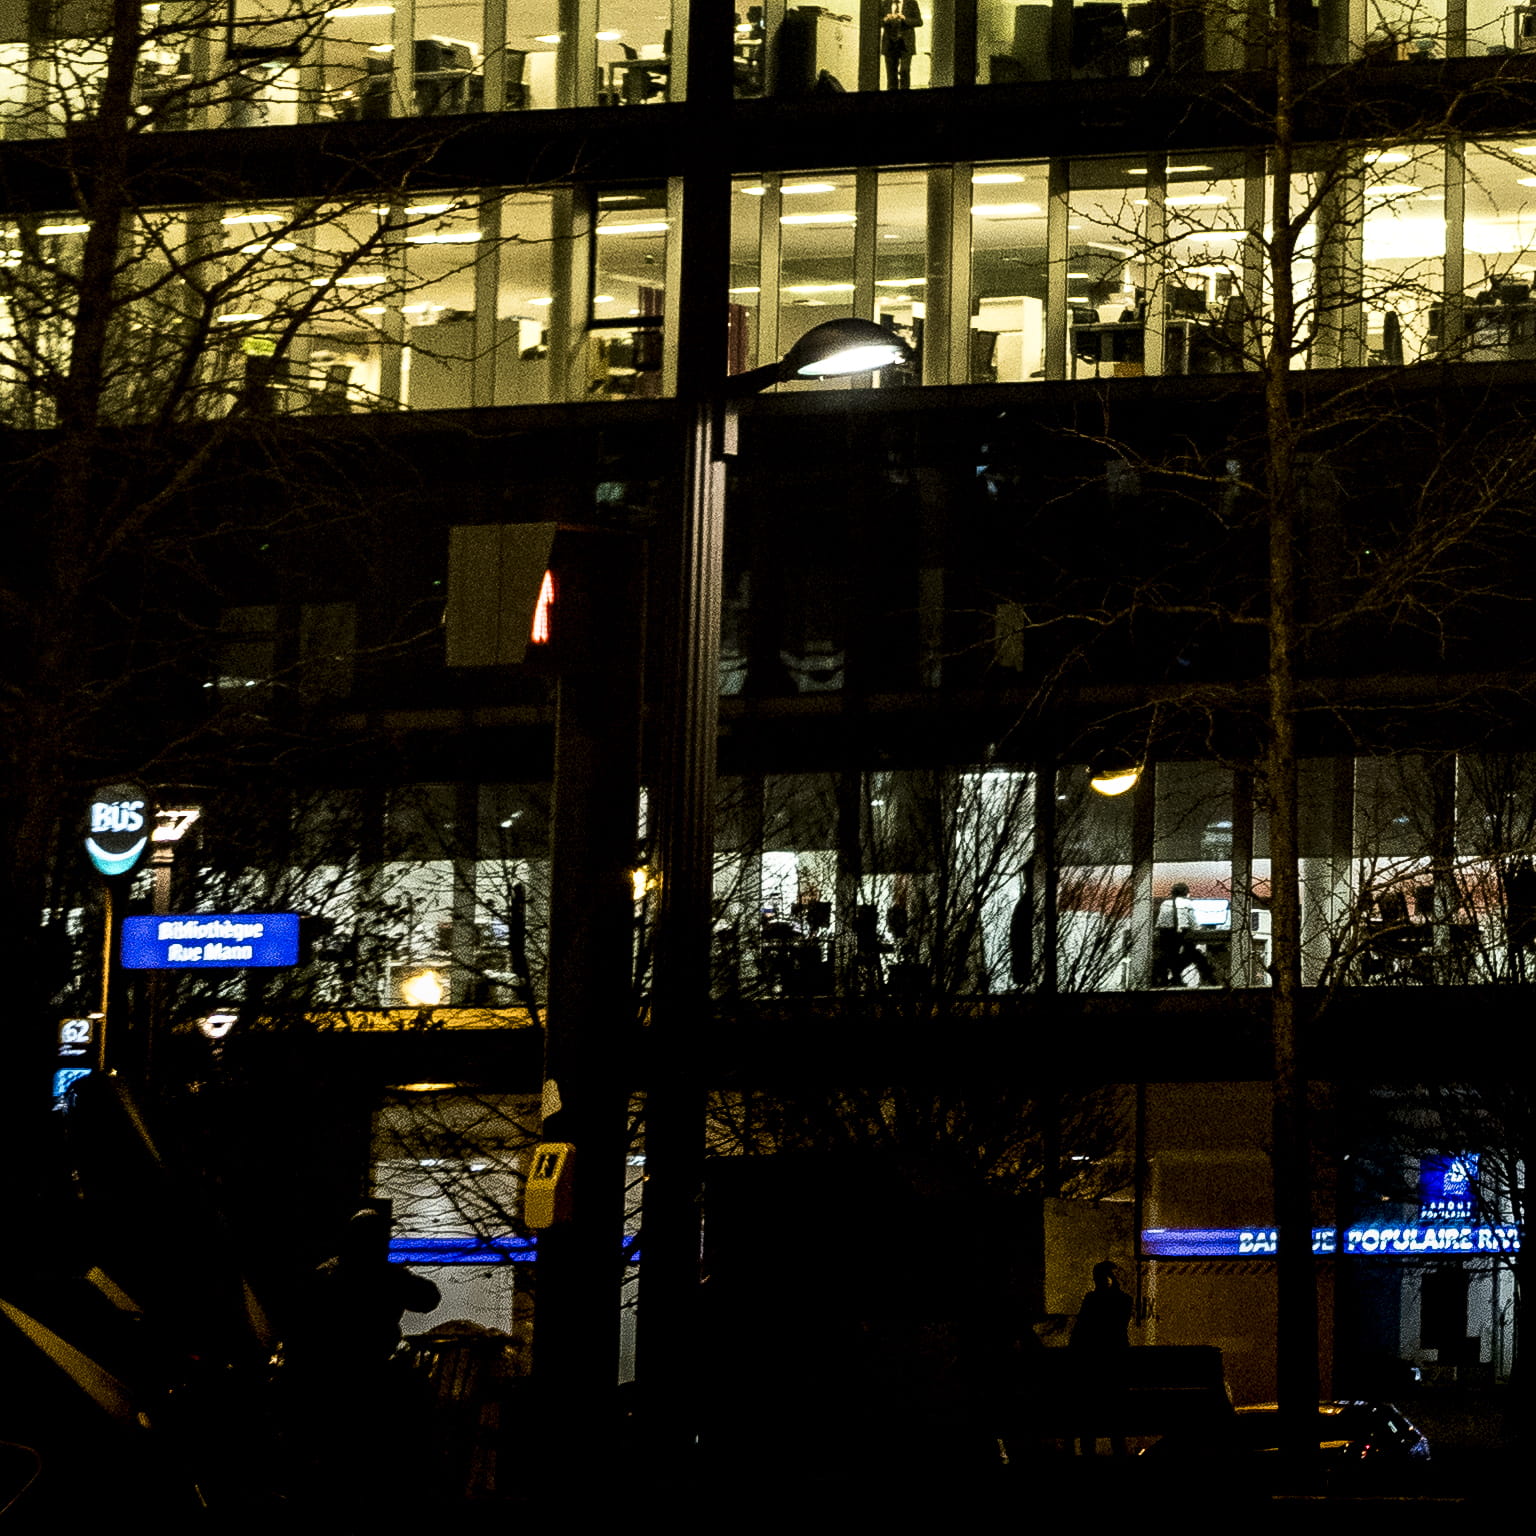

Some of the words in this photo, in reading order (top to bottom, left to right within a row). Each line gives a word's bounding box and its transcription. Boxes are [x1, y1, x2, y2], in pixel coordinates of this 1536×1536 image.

[91, 800, 145, 832] BUS
[157, 920, 264, 942] Bibliothèque
[167, 944, 202, 962] Rue
[61, 1020, 90, 1044] 62
[1347, 1228, 1474, 1251] POPULAIRE
